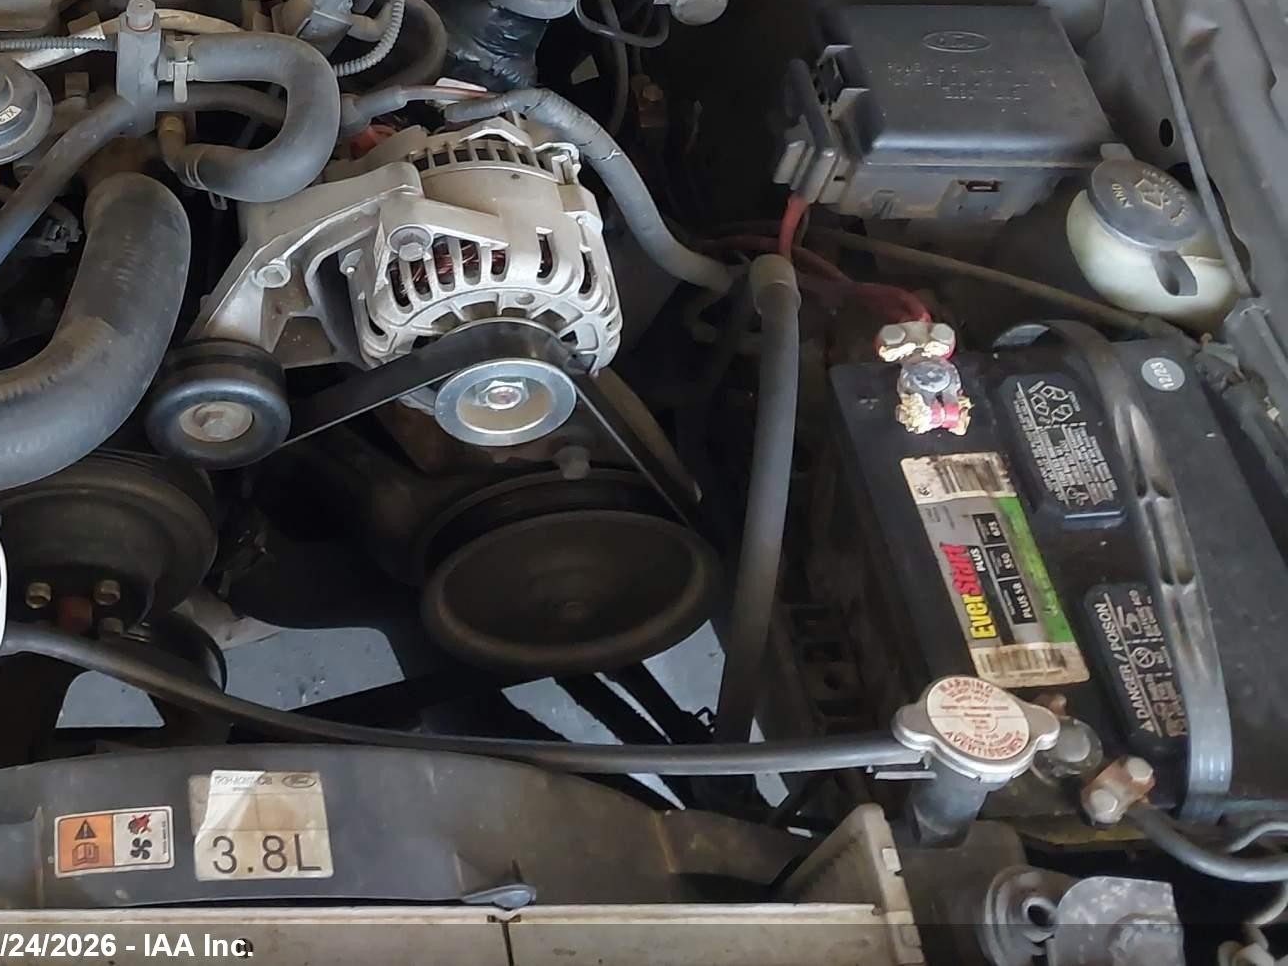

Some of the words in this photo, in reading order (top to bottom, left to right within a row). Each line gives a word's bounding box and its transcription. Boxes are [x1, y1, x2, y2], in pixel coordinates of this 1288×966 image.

[968, 548, 987, 573] PLUS
[939, 543, 997, 640] EverStart
[1017, 595, 1033, 619] PLUS
[1094, 602, 1124, 652] POISON
[1119, 664, 1149, 720] DANGER
[212, 833, 322, 875] 3.8L
